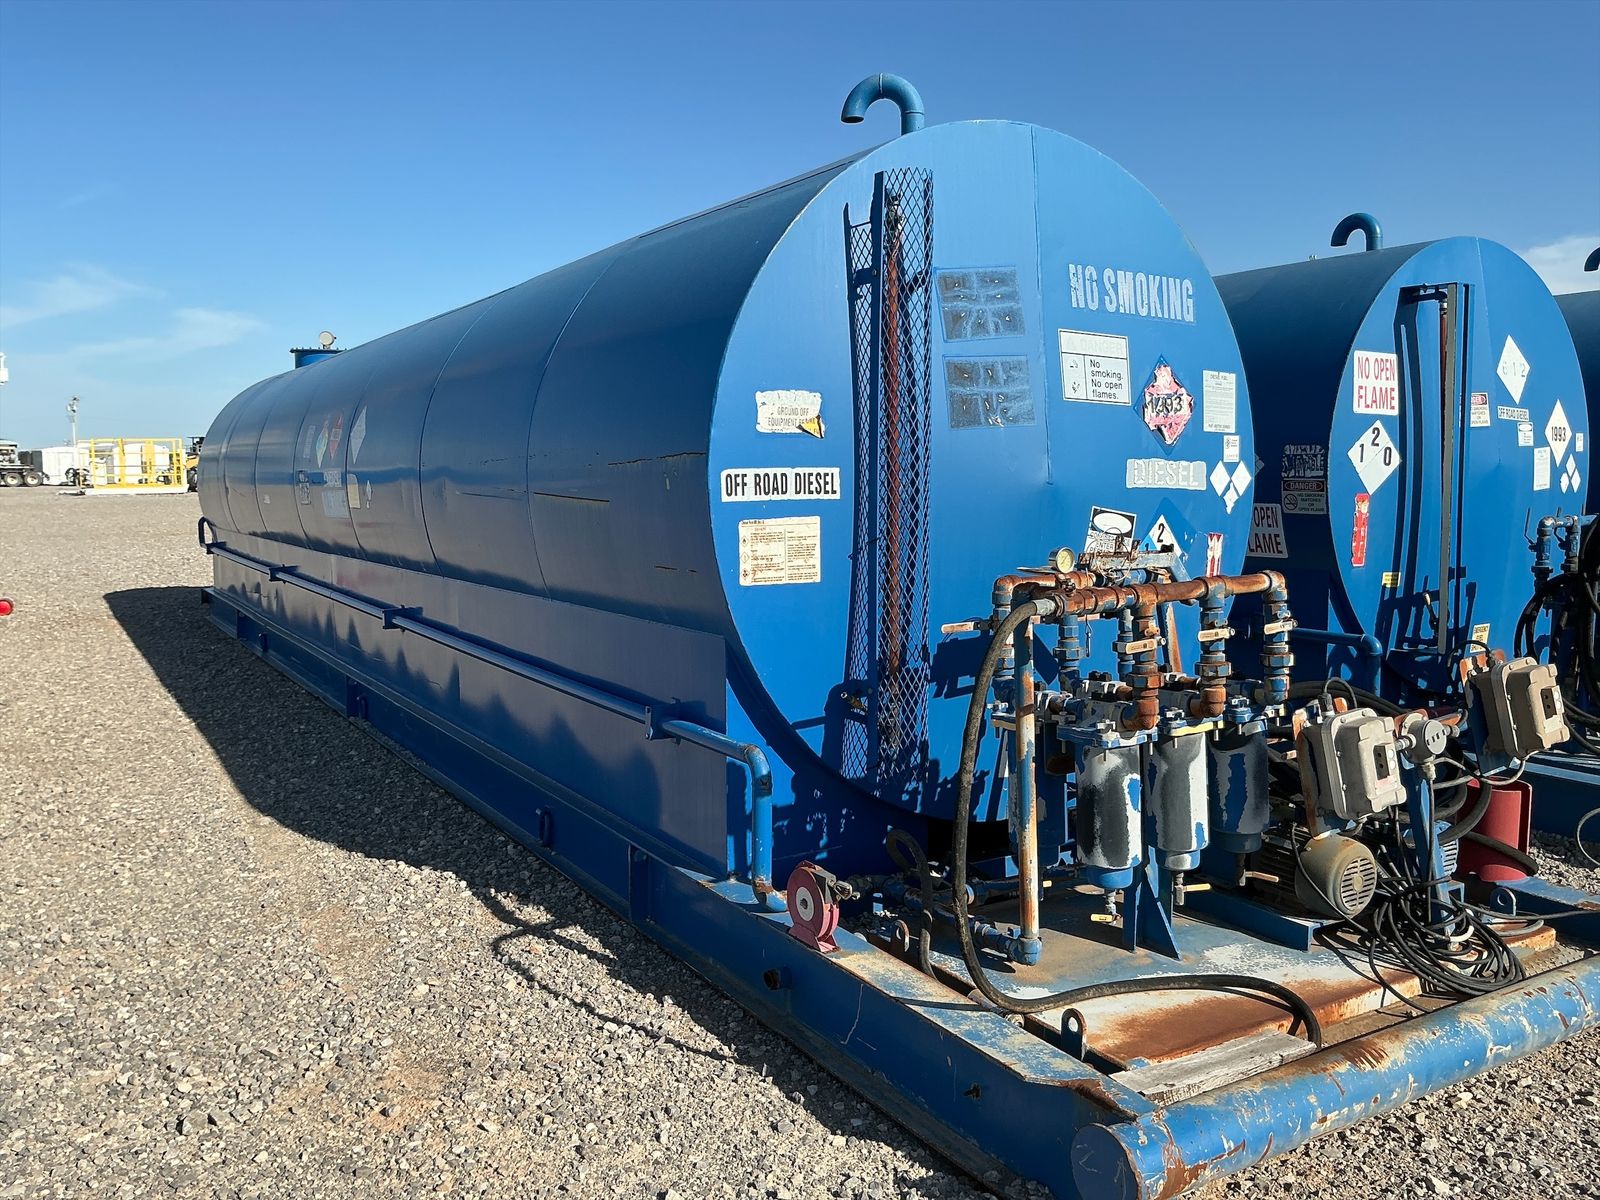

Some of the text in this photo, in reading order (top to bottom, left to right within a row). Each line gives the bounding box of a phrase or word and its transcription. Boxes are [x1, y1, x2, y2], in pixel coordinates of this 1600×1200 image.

[1068, 264, 1194, 322] NO SMOKING
[1089, 359, 1101, 369] No
[1357, 356, 1395, 382] NO OPEN
[1090, 370, 1124, 381] smoking.
[1091, 379, 1123, 390] No open
[1092, 389, 1119, 400] flames.
[1357, 385, 1396, 410] FLAME
[799, 407, 810, 417] OFF
[1370, 427, 1381, 447] 2
[1551, 426, 1567, 442] 1993
[1359, 443, 1392, 467] 1 0
[1133, 460, 1199, 486] DIESEL
[725, 472, 837, 497] OFF ROAD DIESEL
[1290, 482, 1317, 490] DANGER
[1253, 506, 1278, 528] OPEN
[1157, 523, 1165, 543] 2
[1144, 542, 1149, 551] 1
[1248, 533, 1283, 554] LAME
